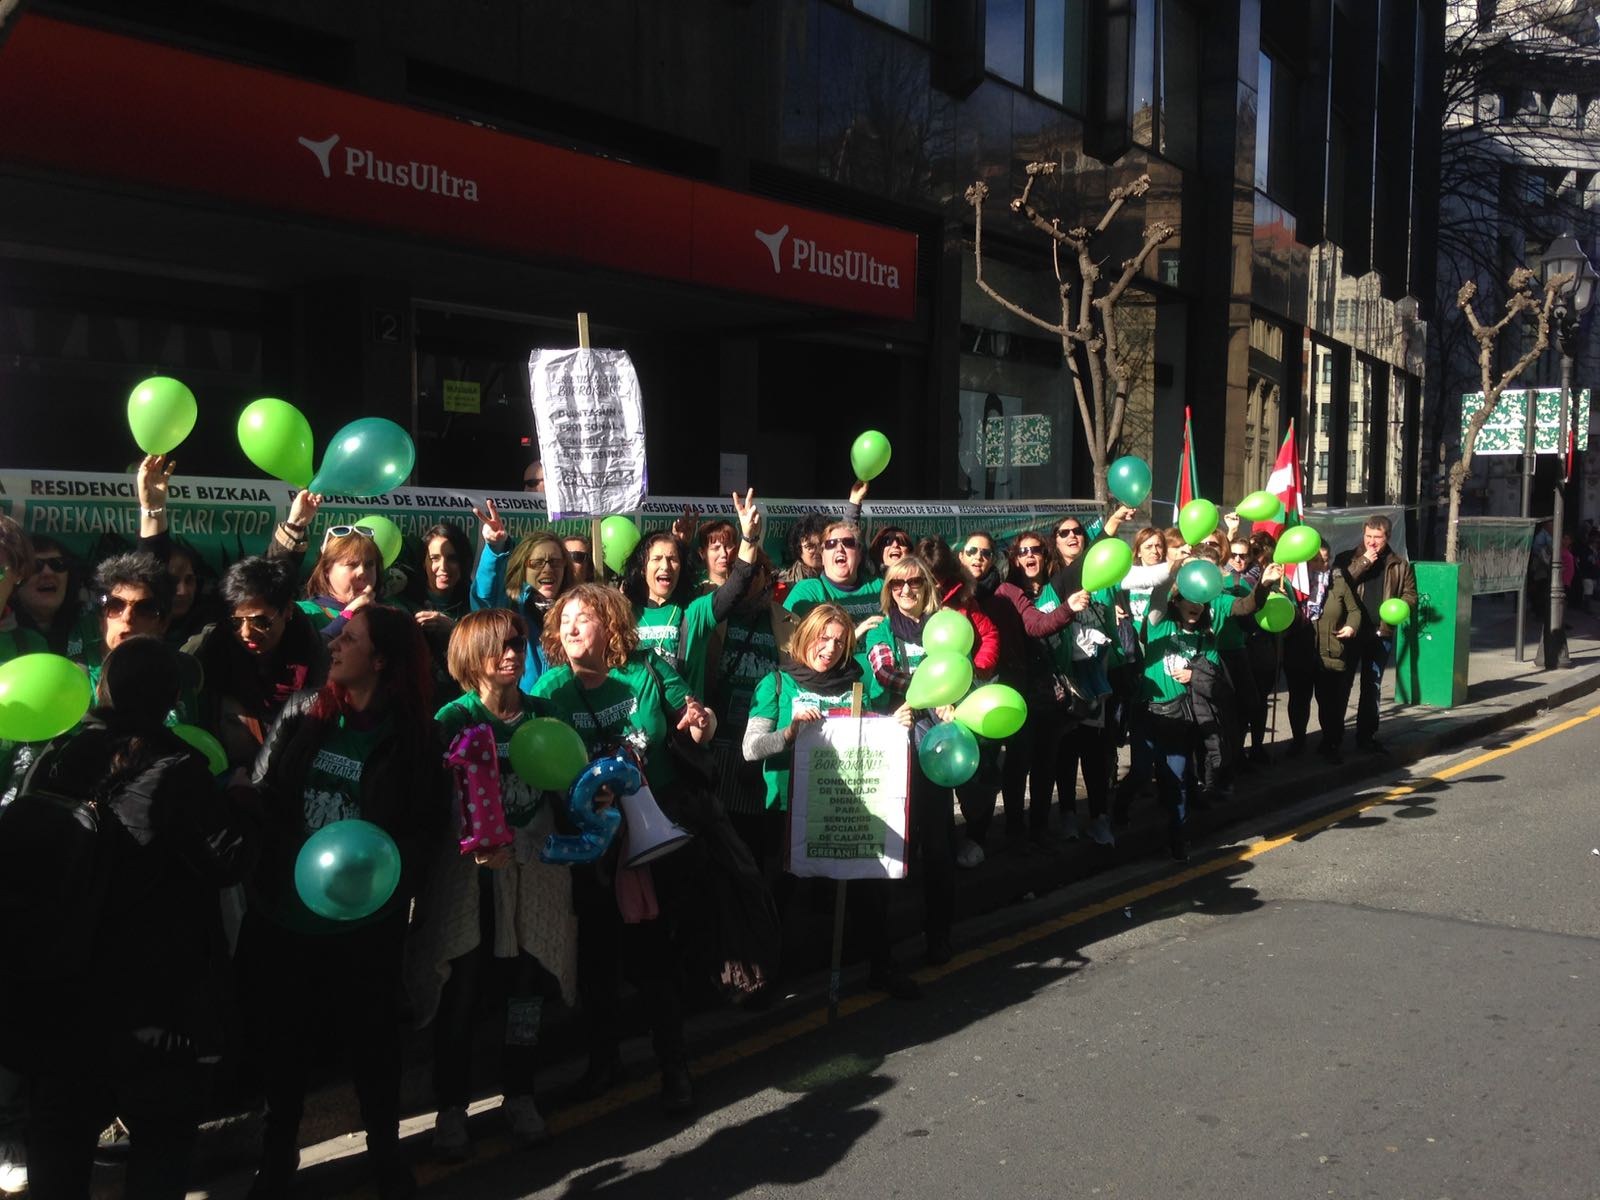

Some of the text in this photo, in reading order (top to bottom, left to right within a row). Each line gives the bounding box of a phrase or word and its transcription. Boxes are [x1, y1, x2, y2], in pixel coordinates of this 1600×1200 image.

[345, 146, 479, 202] PlusUltra
[792, 238, 900, 289] PlusUltra
[382, 314, 397, 341] 2
[30, 480, 271, 502] RESIDENCI DE BIZKAIA
[395, 494, 413, 506] DE
[417, 495, 474, 509] BIZKAIA
[642, 502, 705, 514] RESIDENCIAS
[706, 504, 720, 514] DE
[821, 505, 833, 514] DE
[870, 505, 954, 515] RESIDENCIAS DE BIZKAIA
[220, 509, 270, 535] STOP
[817, 778, 880, 786] CONDICIONES
[819, 786, 877, 795] DE TRABAJO
[835, 806, 862, 814] PARA
[823, 815, 871, 823] SERVICIOS
[824, 825, 870, 833] SOCIALES
[834, 834, 874, 842] CALIDAD
